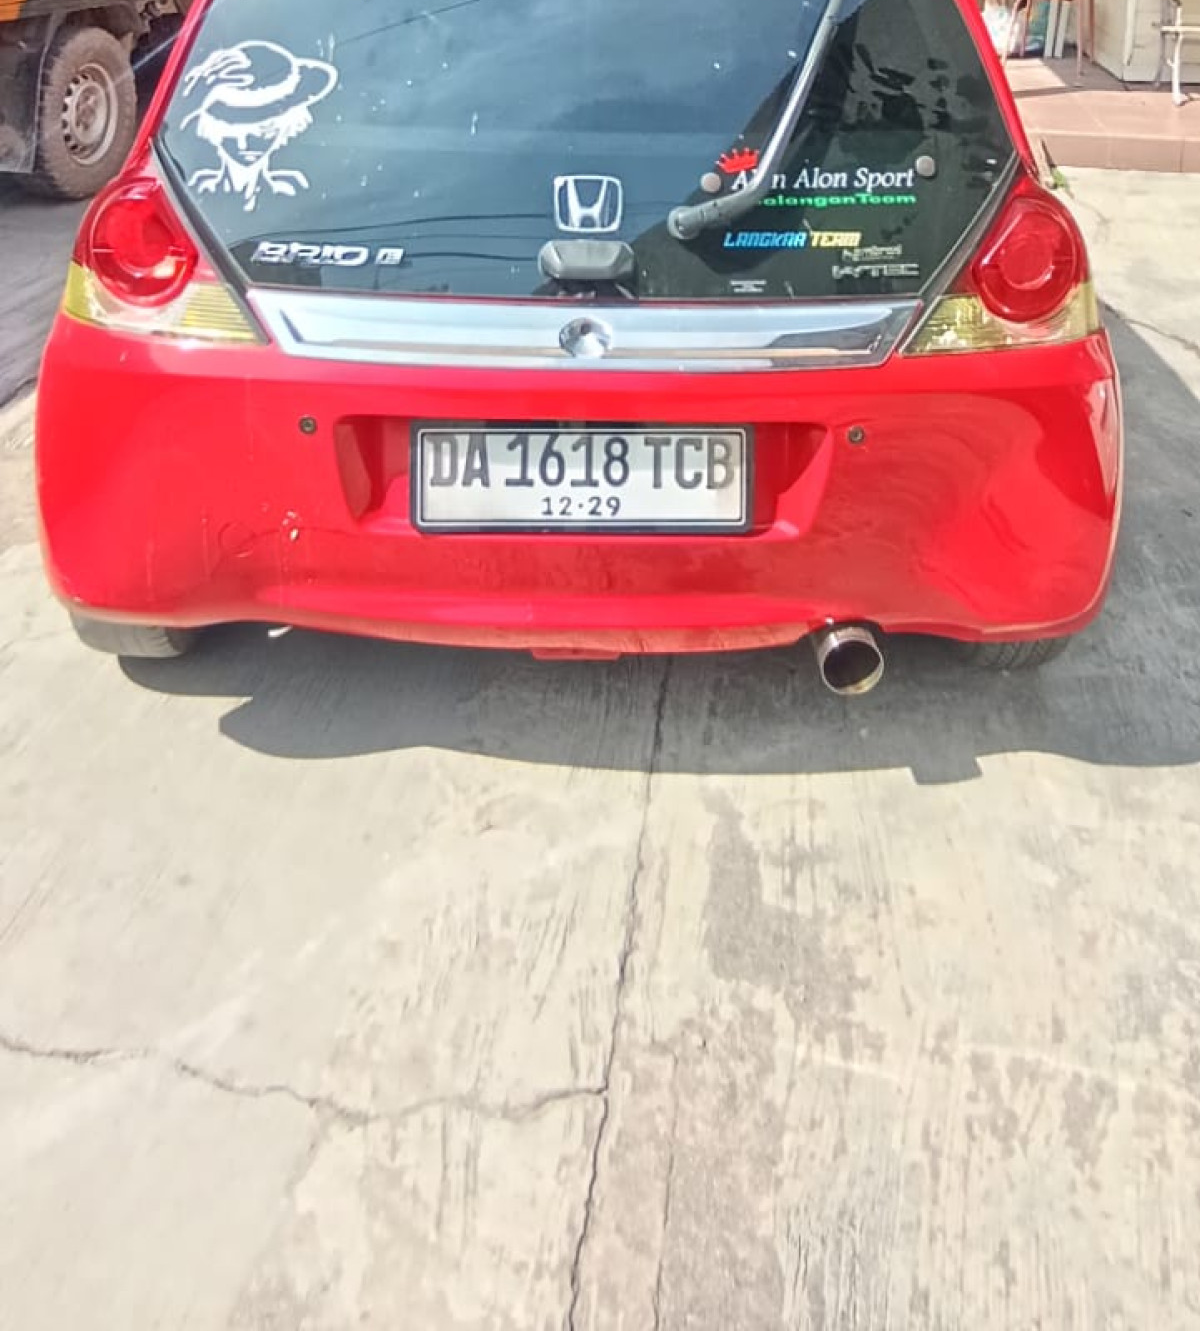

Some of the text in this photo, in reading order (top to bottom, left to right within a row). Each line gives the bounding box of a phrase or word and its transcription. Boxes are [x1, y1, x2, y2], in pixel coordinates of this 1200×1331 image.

[731, 167, 915, 193] An Alon Sport
[427, 432, 735, 489] DA 1618 TCB
